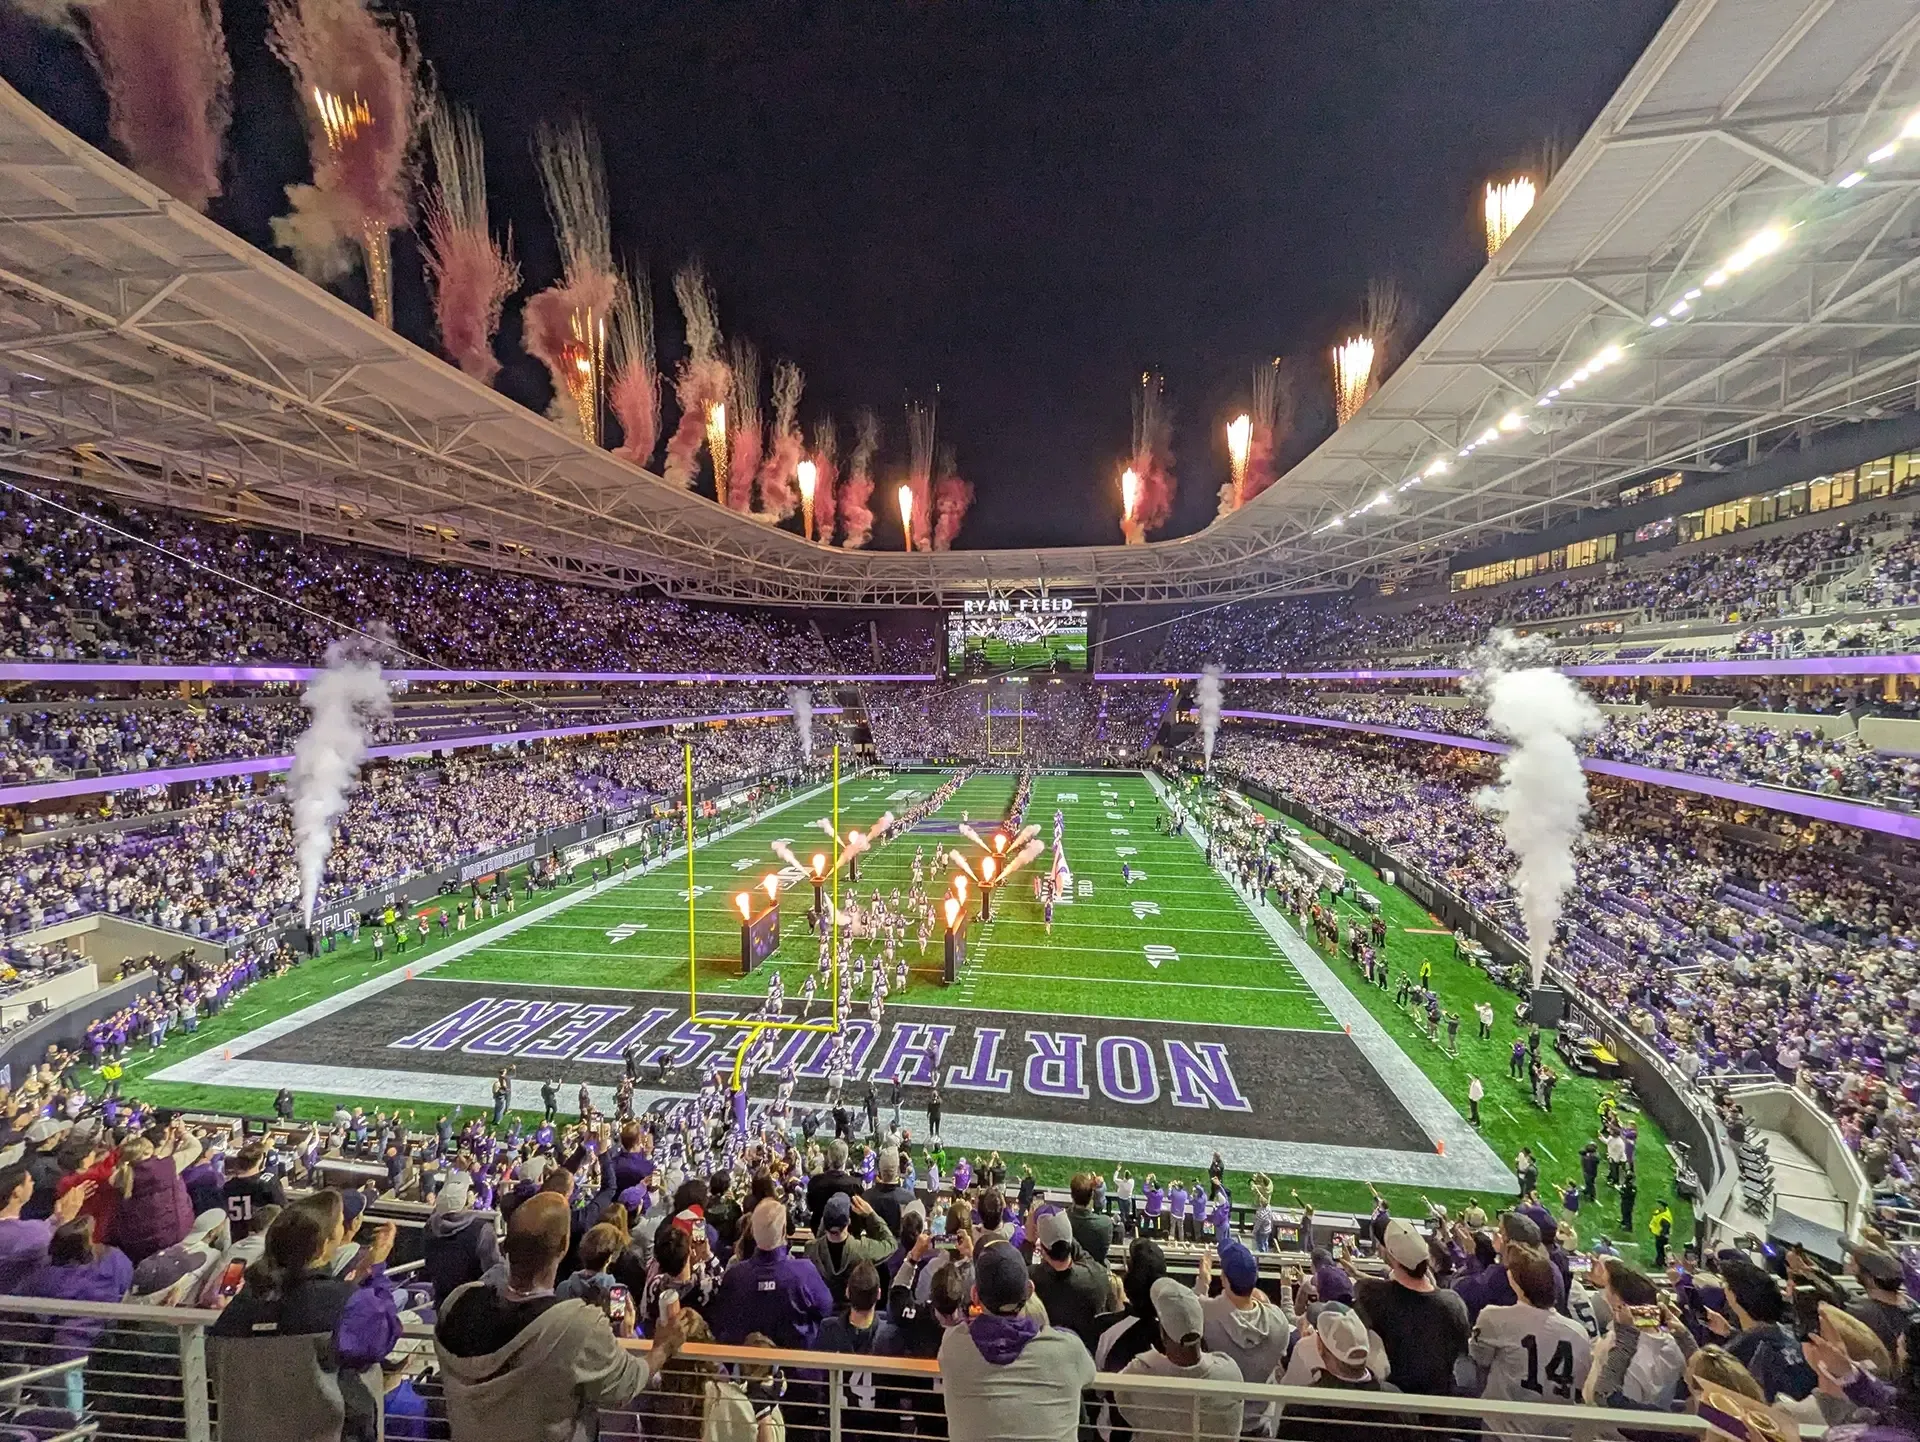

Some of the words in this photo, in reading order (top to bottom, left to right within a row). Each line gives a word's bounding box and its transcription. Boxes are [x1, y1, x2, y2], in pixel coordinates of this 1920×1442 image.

[964, 600, 1010, 612] RYAN
[1020, 599, 1073, 611] FIELD
[461, 843, 536, 881] NORTHWESTERN
[1078, 880, 1094, 897] FIELD
[1143, 944, 1180, 961] 10
[386, 997, 1253, 1113] NORTHWESTERN
[228, 1195, 252, 1221] 51
[1521, 1334, 1576, 1399] 14
